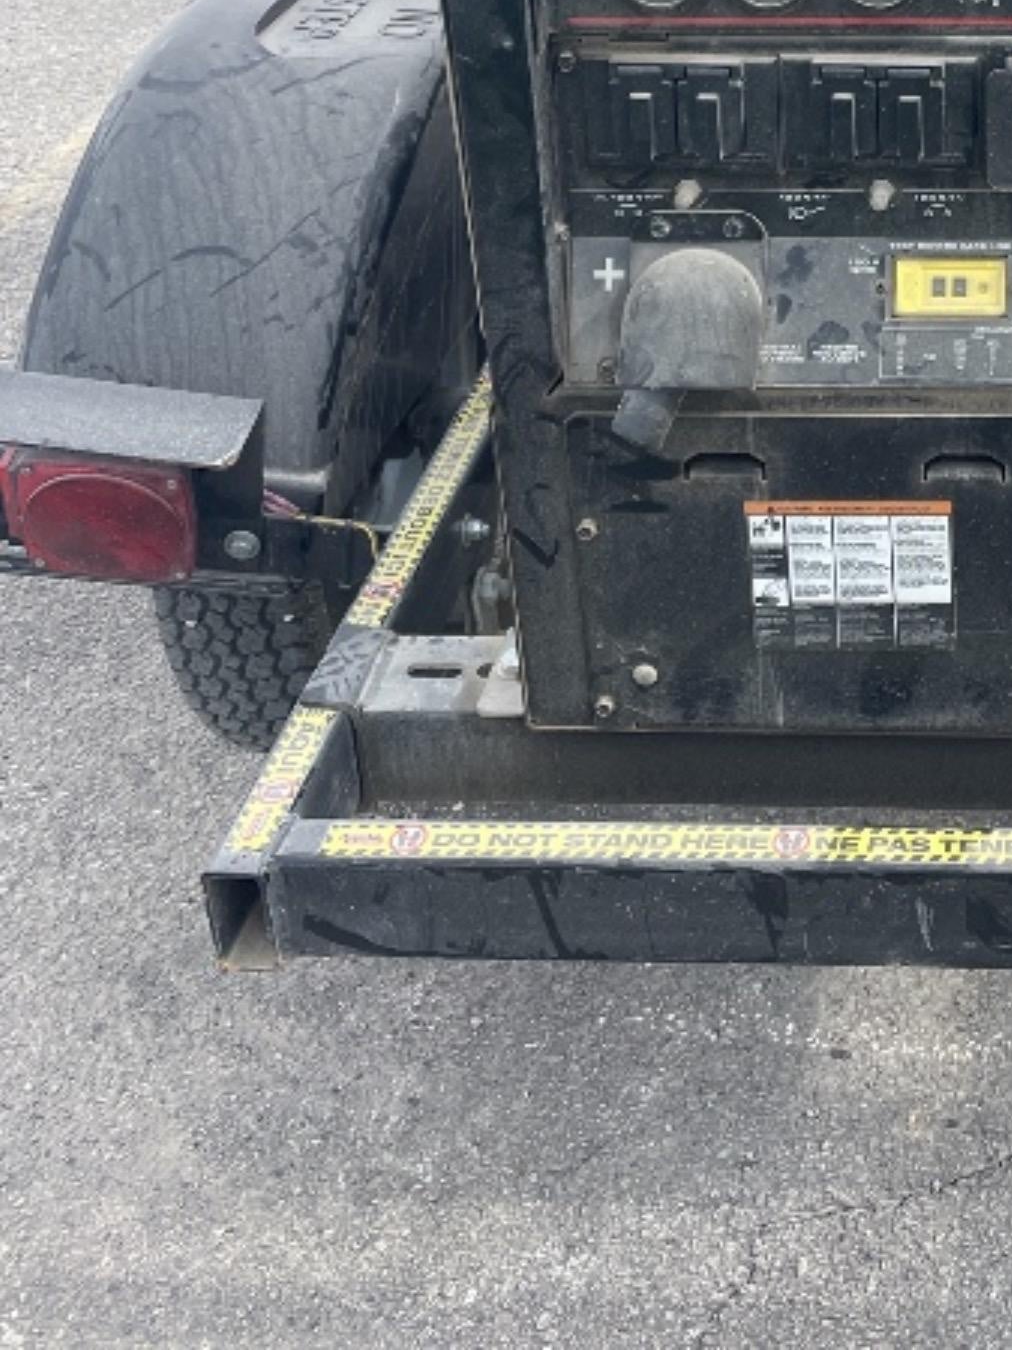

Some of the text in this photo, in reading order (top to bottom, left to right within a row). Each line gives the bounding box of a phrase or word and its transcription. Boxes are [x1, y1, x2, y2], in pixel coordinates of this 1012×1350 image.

[431, 832, 770, 851] DO NOT STAND HERE
[814, 835, 861, 852] NE
[864, 836, 932, 853] PAS
